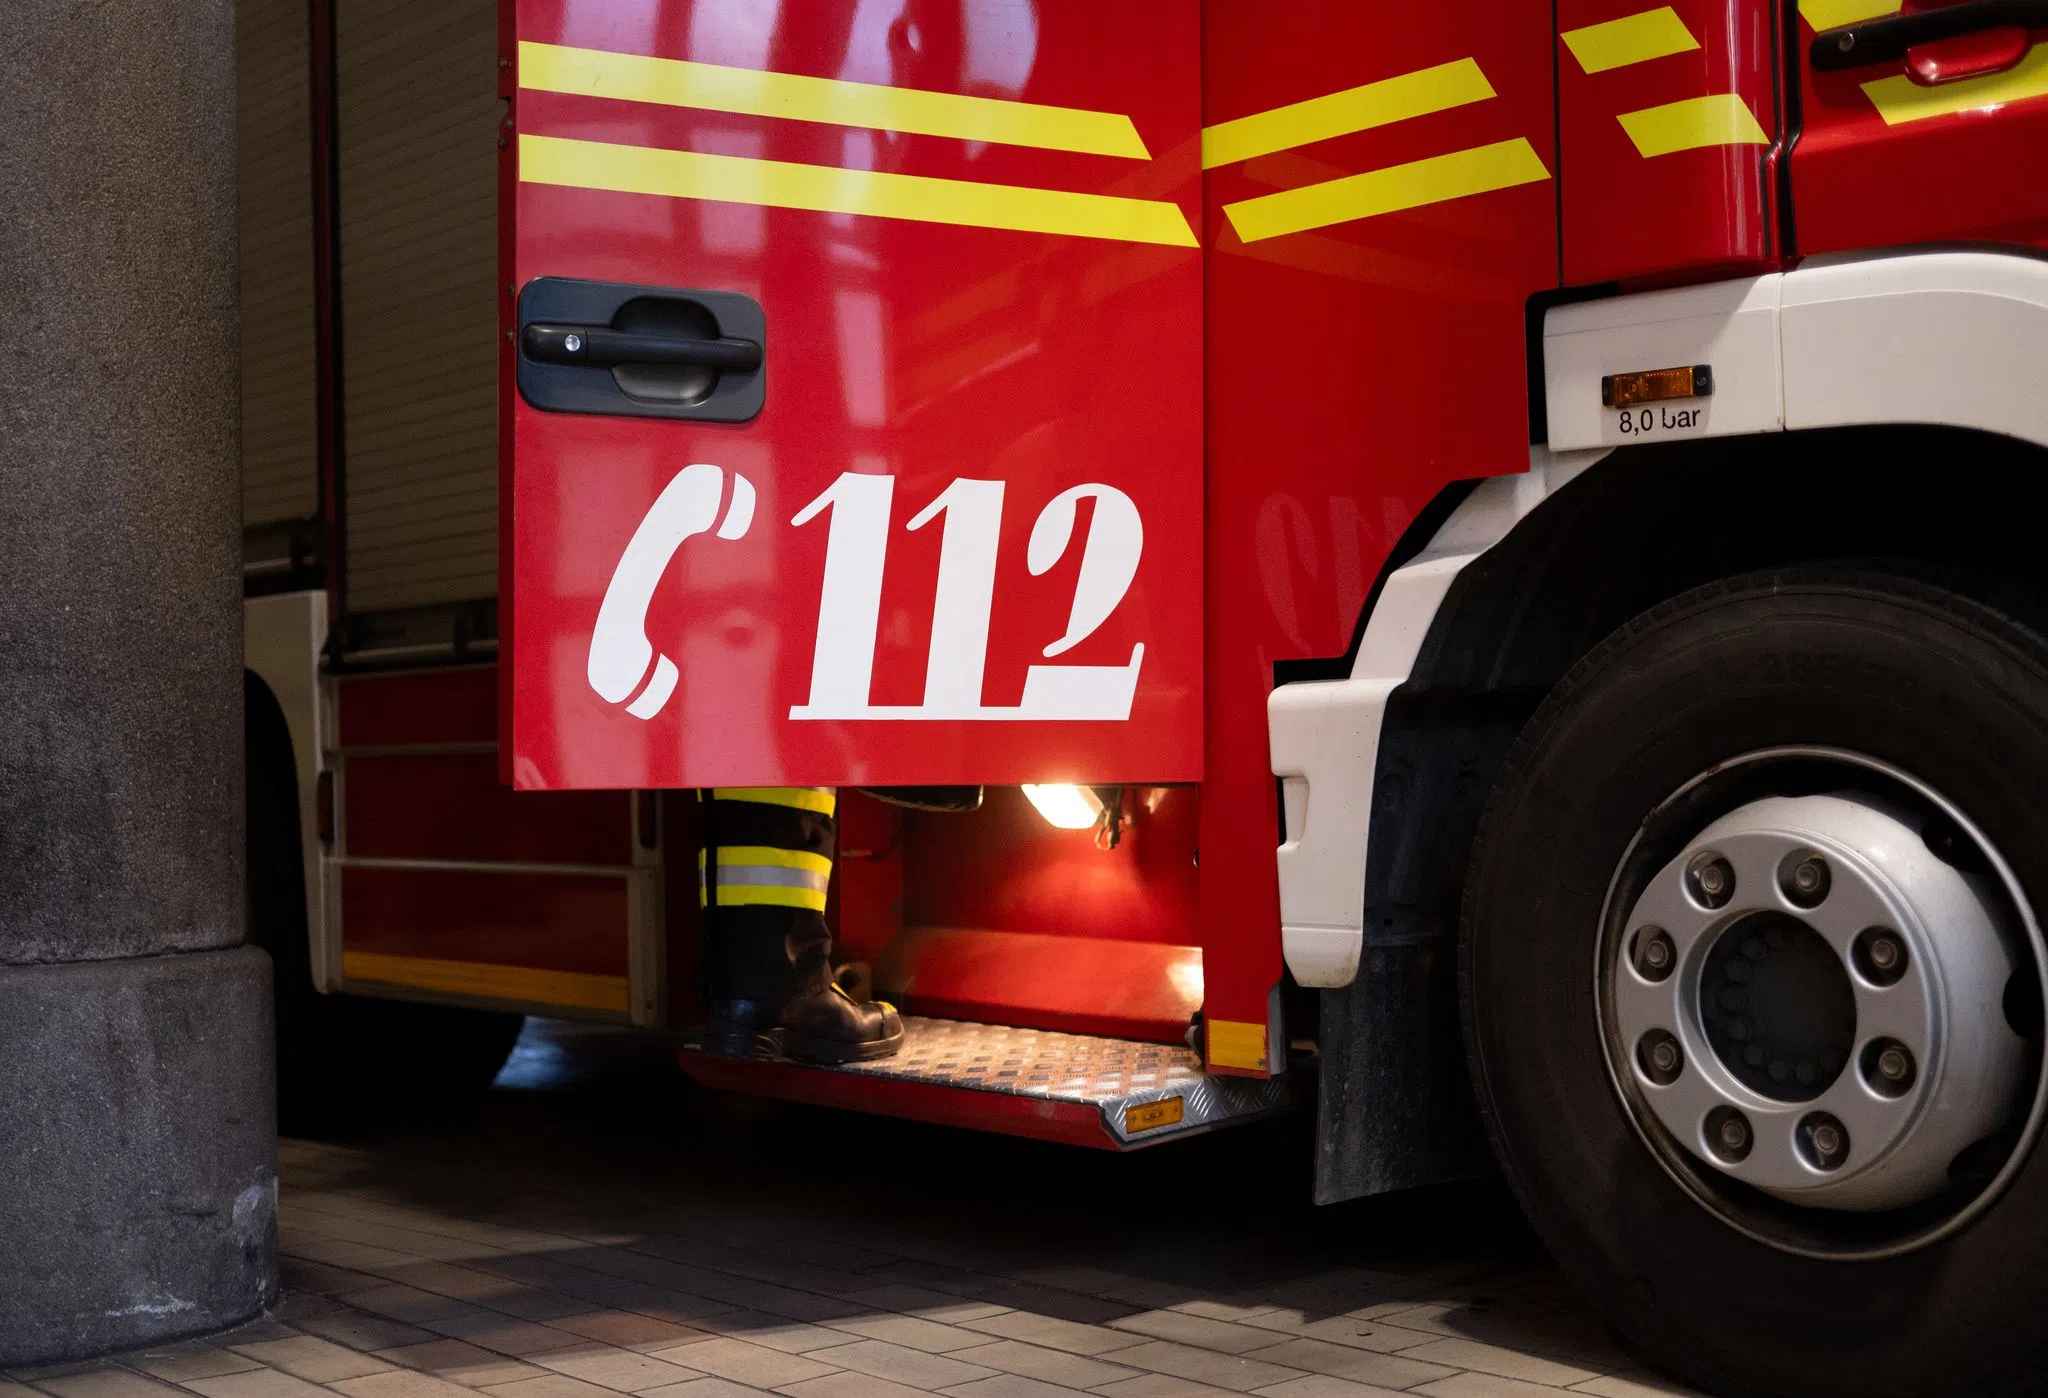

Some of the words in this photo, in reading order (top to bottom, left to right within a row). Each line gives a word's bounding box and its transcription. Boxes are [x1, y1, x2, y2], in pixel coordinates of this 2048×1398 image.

[1619, 409, 1654, 436] 8,0
[1662, 407, 1701, 429] bar
[788, 471, 1145, 721] 112
